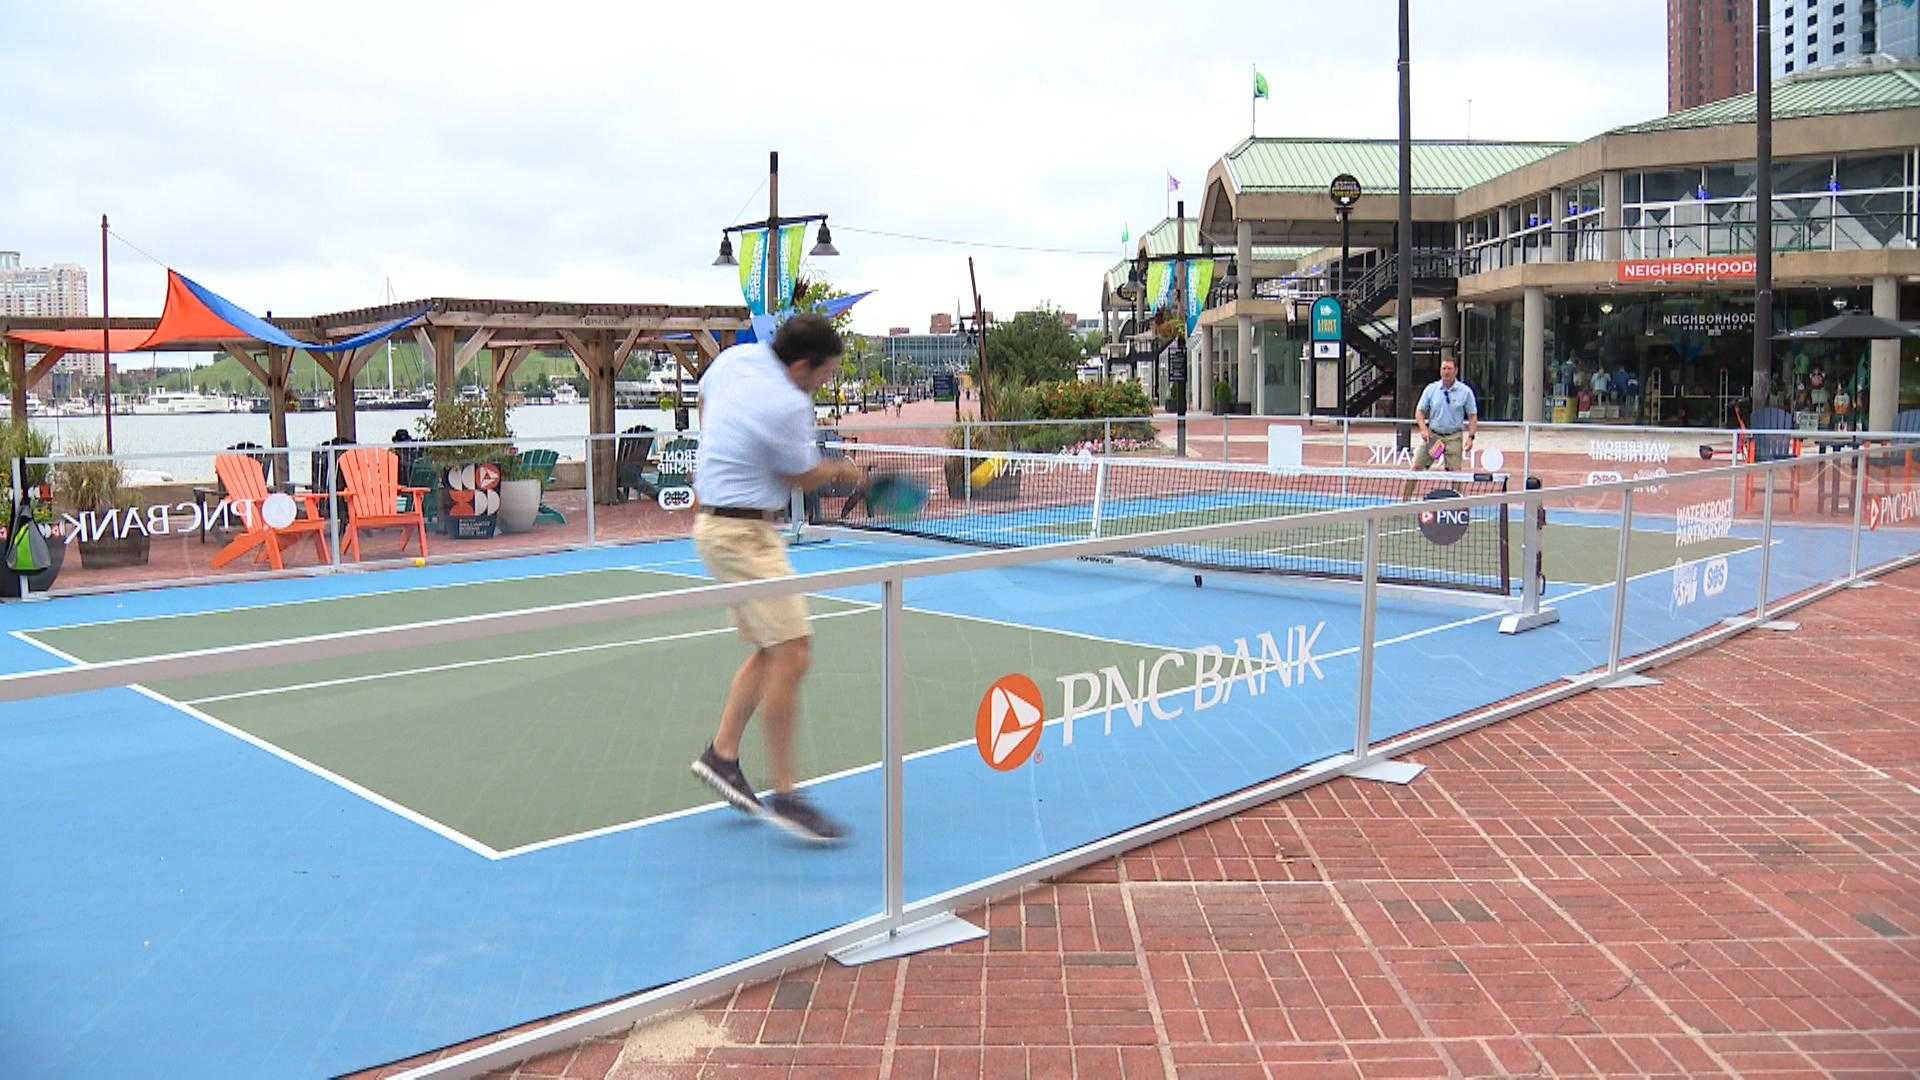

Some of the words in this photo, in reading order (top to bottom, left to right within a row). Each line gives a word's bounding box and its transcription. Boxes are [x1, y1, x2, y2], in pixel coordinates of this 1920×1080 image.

[1663, 313, 1756, 325] NEIGHBORHOOD
[1436, 511, 1469, 524] PNC
[1676, 499, 1732, 526] WATERFRONT
[1901, 490, 1920, 520] BAN
[1675, 517, 1731, 547] PARTNERSHIP
[1056, 652, 1184, 746] PNC
[1194, 621, 1325, 712] BANK
